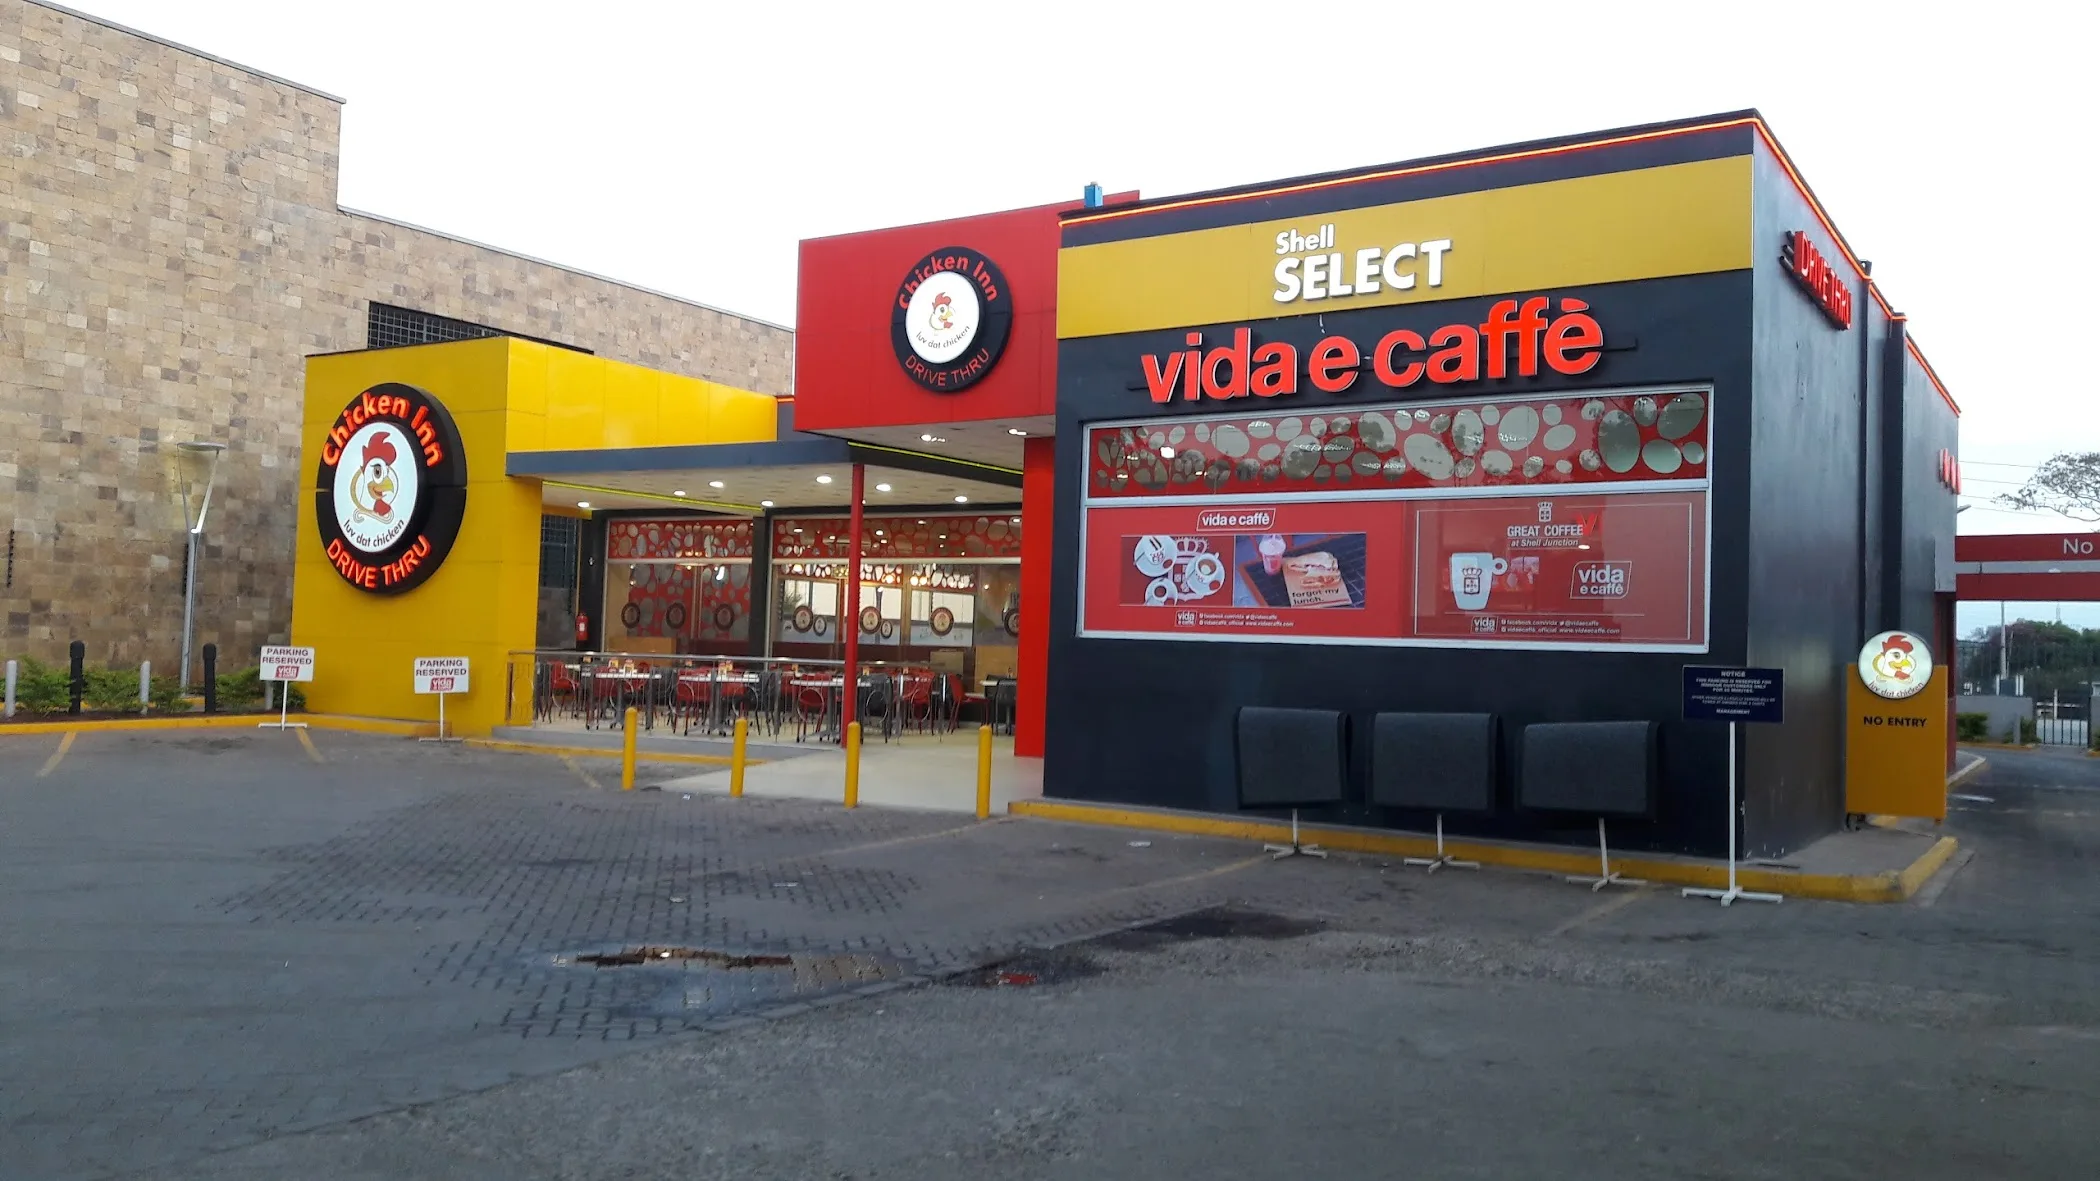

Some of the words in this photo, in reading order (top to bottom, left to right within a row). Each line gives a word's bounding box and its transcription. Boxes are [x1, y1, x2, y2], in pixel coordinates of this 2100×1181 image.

[1275, 223, 1335, 255] Shell
[1272, 239, 1453, 303] SELECT
[898, 255, 969, 310] Chicken
[973, 260, 998, 302] Inn
[916, 331, 927, 344] luv
[928, 339, 941, 349] dat
[943, 325, 971, 348] chicken
[1140, 327, 1297, 404] vida
[1308, 336, 1360, 393] e
[1374, 296, 1604, 389] caffè
[904, 354, 947, 386] DRIVE
[951, 348, 990, 384] THRU
[322, 391, 411, 467] Chicken
[410, 404, 445, 468] Inn
[1202, 513, 1227, 526] vida
[1228, 515, 1236, 526] e
[1238, 513, 1270, 526] caffè
[343, 519, 356, 538] luv
[356, 532, 371, 548] dat
[373, 519, 405, 548] chicken
[1507, 525, 1541, 537] GREAT
[1544, 524, 1584, 537] COFFEE
[1520, 539, 1541, 547] Shell
[1542, 538, 1579, 547] Junction
[2063, 538, 2094, 555] No
[326, 537, 378, 589] DRIVE
[381, 534, 432, 587] THRU
[1578, 564, 1624, 583] vida
[1291, 590, 1322, 599] forgot
[1324, 588, 1340, 597] my
[1580, 585, 1588, 594] e
[1590, 583, 1624, 595] caffè
[1474, 617, 1495, 626] vida
[262, 656, 312, 665] RESERVED
[266, 648, 309, 657] PARKING
[419, 659, 463, 668] PARKING
[415, 668, 467, 677] RESERVED
[1896, 682, 1924, 698] chicken
[1863, 716, 1883, 725] NO
[1888, 717, 1928, 727] ENTRY
